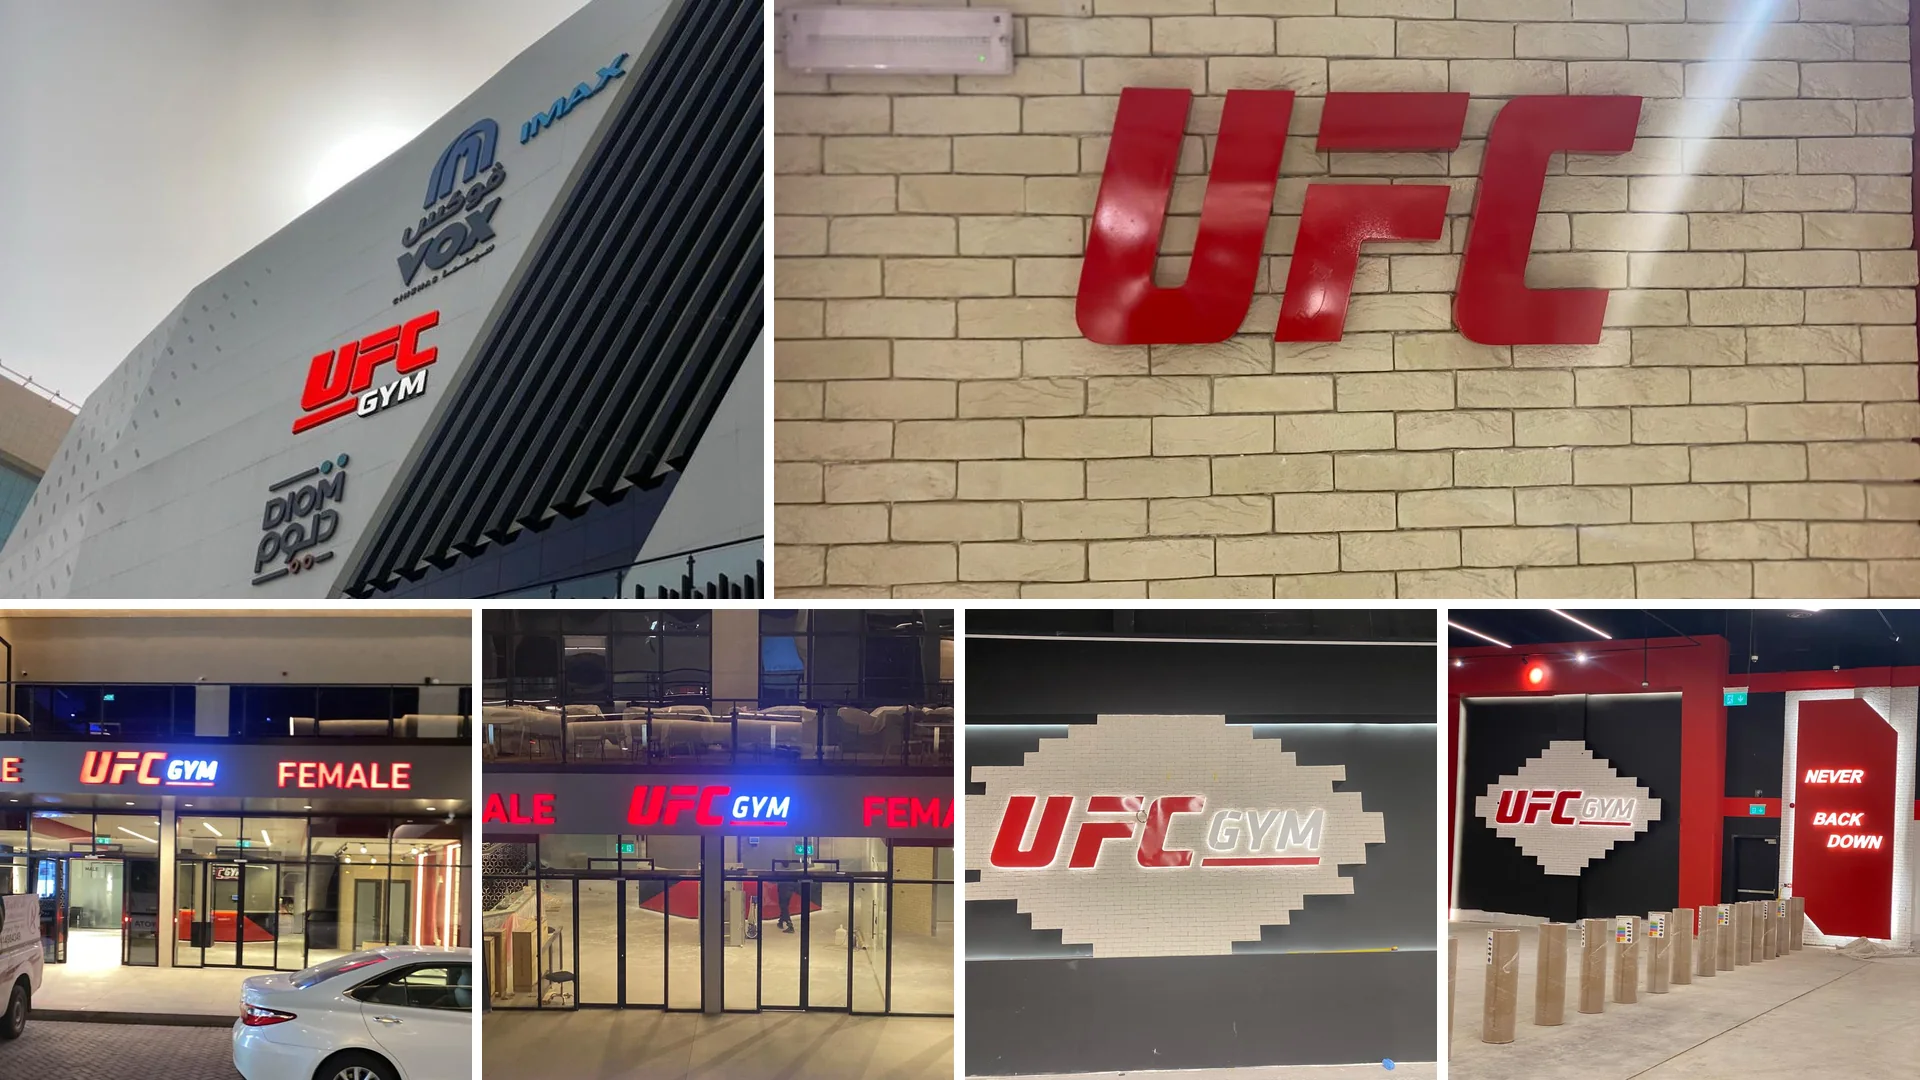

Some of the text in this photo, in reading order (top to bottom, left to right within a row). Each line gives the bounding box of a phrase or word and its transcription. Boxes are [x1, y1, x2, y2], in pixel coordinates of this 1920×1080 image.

[520, 53, 629, 145] IMAX
[402, 161, 507, 248] فوكس
[1075, 87, 1643, 346] UFC
[397, 197, 502, 287] VOX
[392, 275, 419, 305] CINEMAS
[301, 310, 440, 412] UFC
[357, 369, 428, 418] GYM
[262, 470, 346, 531] DIOM
[79, 751, 218, 785] UFC GYM
[277, 761, 412, 790] FEMALE
[1804, 769, 1865, 784] NEVER
[627, 785, 791, 826] UFC GYM
[1495, 789, 1637, 825] UFC GYM
[1812, 811, 1865, 827] BACK
[989, 795, 1324, 869] UFC GYM
[1826, 834, 1884, 849] DOWN
